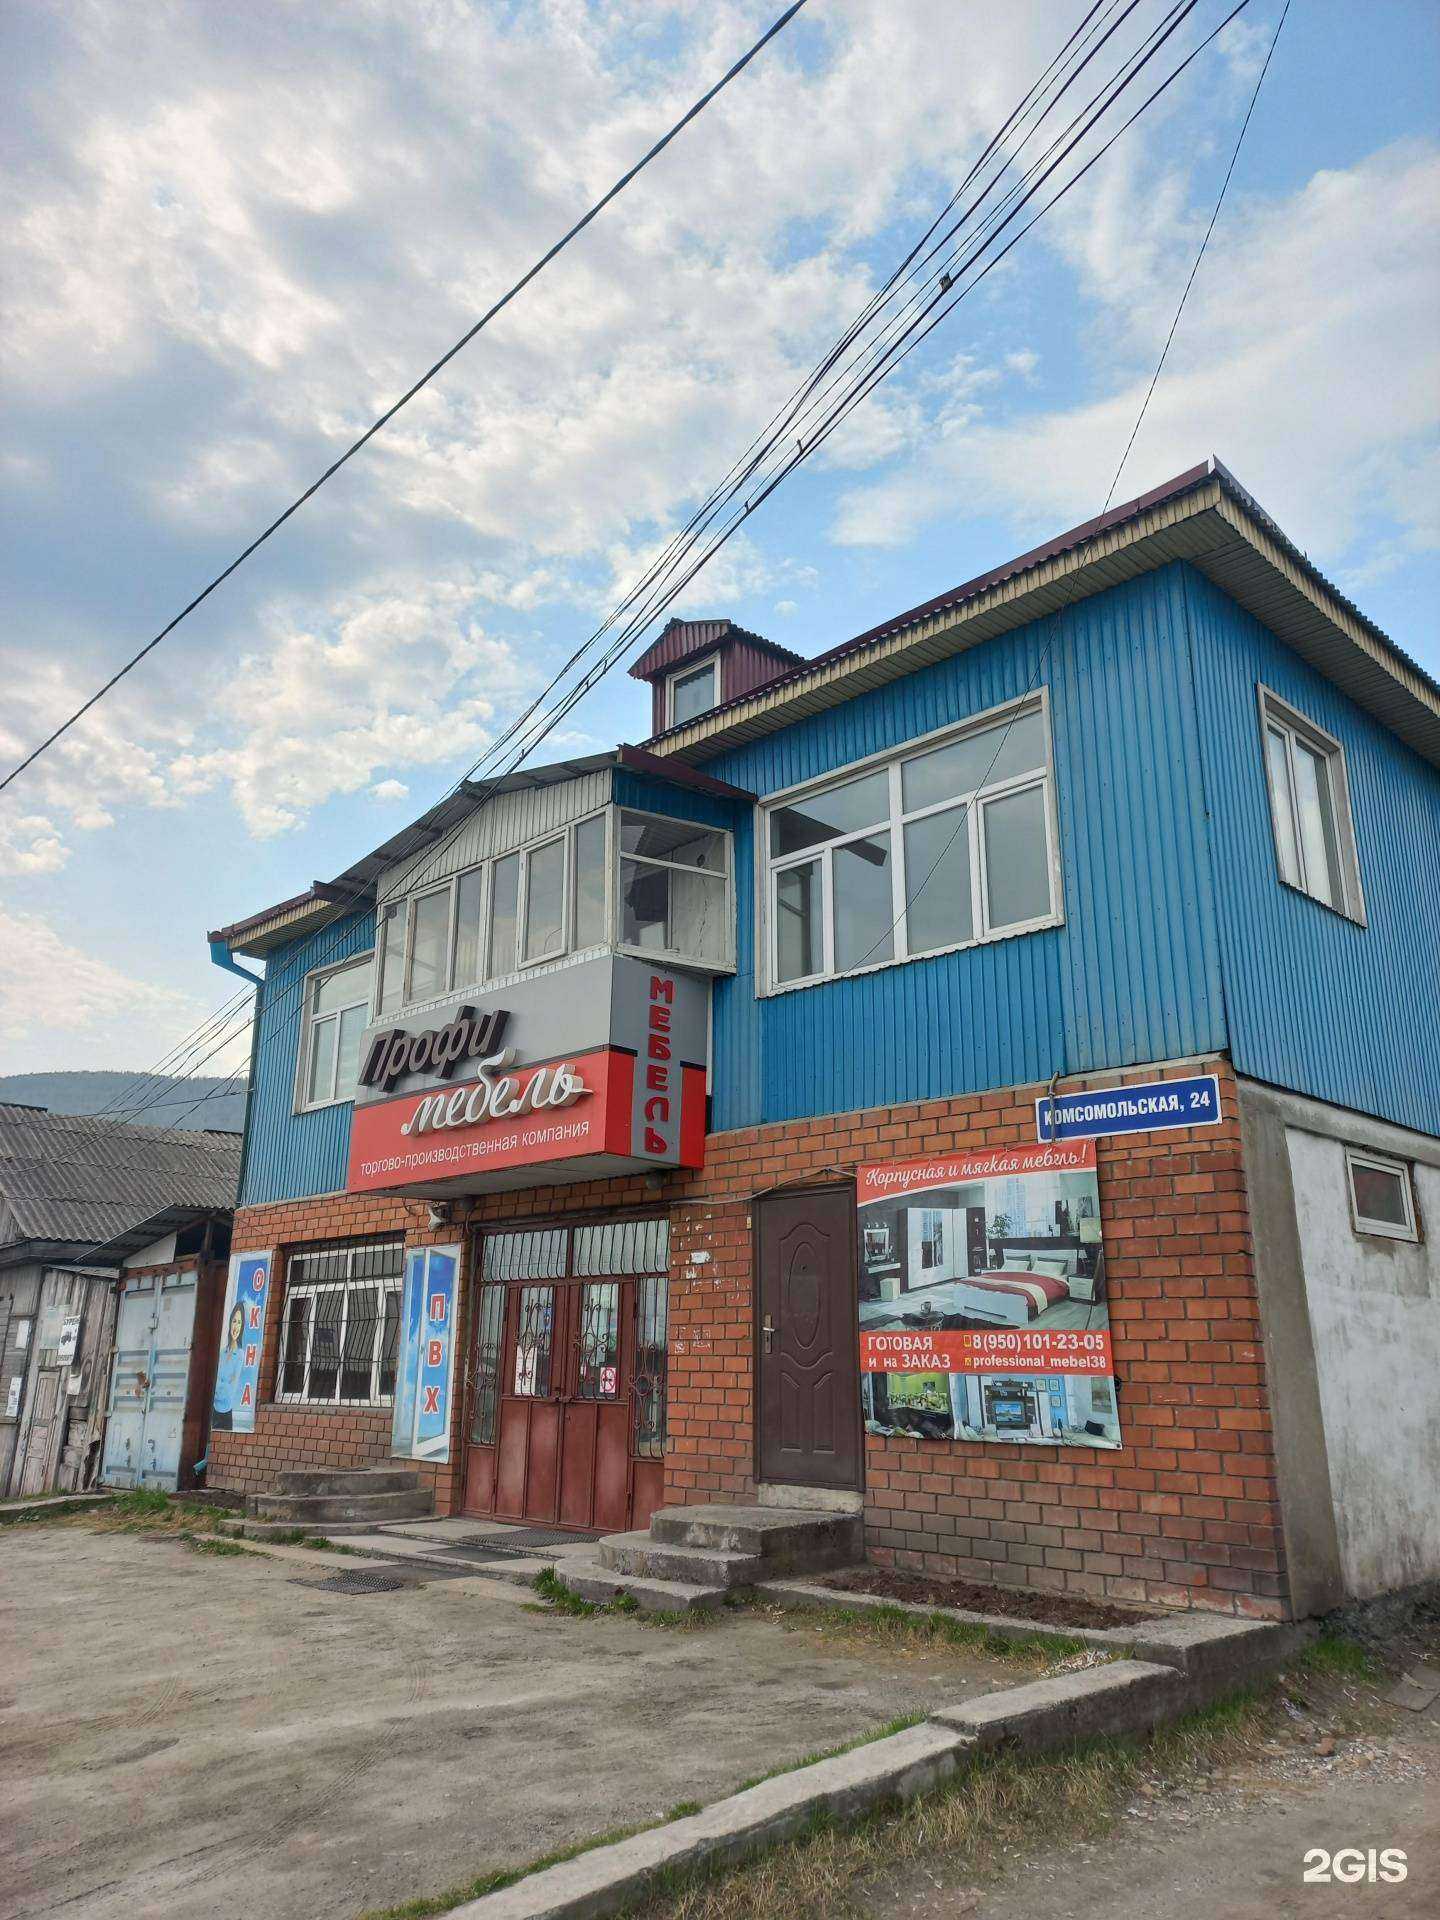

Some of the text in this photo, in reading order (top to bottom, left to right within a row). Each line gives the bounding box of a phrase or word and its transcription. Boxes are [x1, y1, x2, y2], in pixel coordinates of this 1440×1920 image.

[358, 1004, 512, 1093] Профи
[644, 975, 675, 1155] МЕБЕЛЬ
[400, 1046, 594, 1137] мебель
[1044, 1090, 1211, 1126] КОМСОМОЛЬСКАЯ, 24
[359, 1120, 590, 1178] торгово-производственная компания
[865, 1143, 1087, 1189] Корпусная и мягкая мебель!
[240, 1267, 266, 1407] ОКНА
[422, 1293, 447, 1415] ПВХ
[867, 1336, 933, 1351] ГОТОВАЯ
[868, 1353, 951, 1368] и на ЗАКАЗ
[973, 1355, 1106, 1369] professional_mebel38
